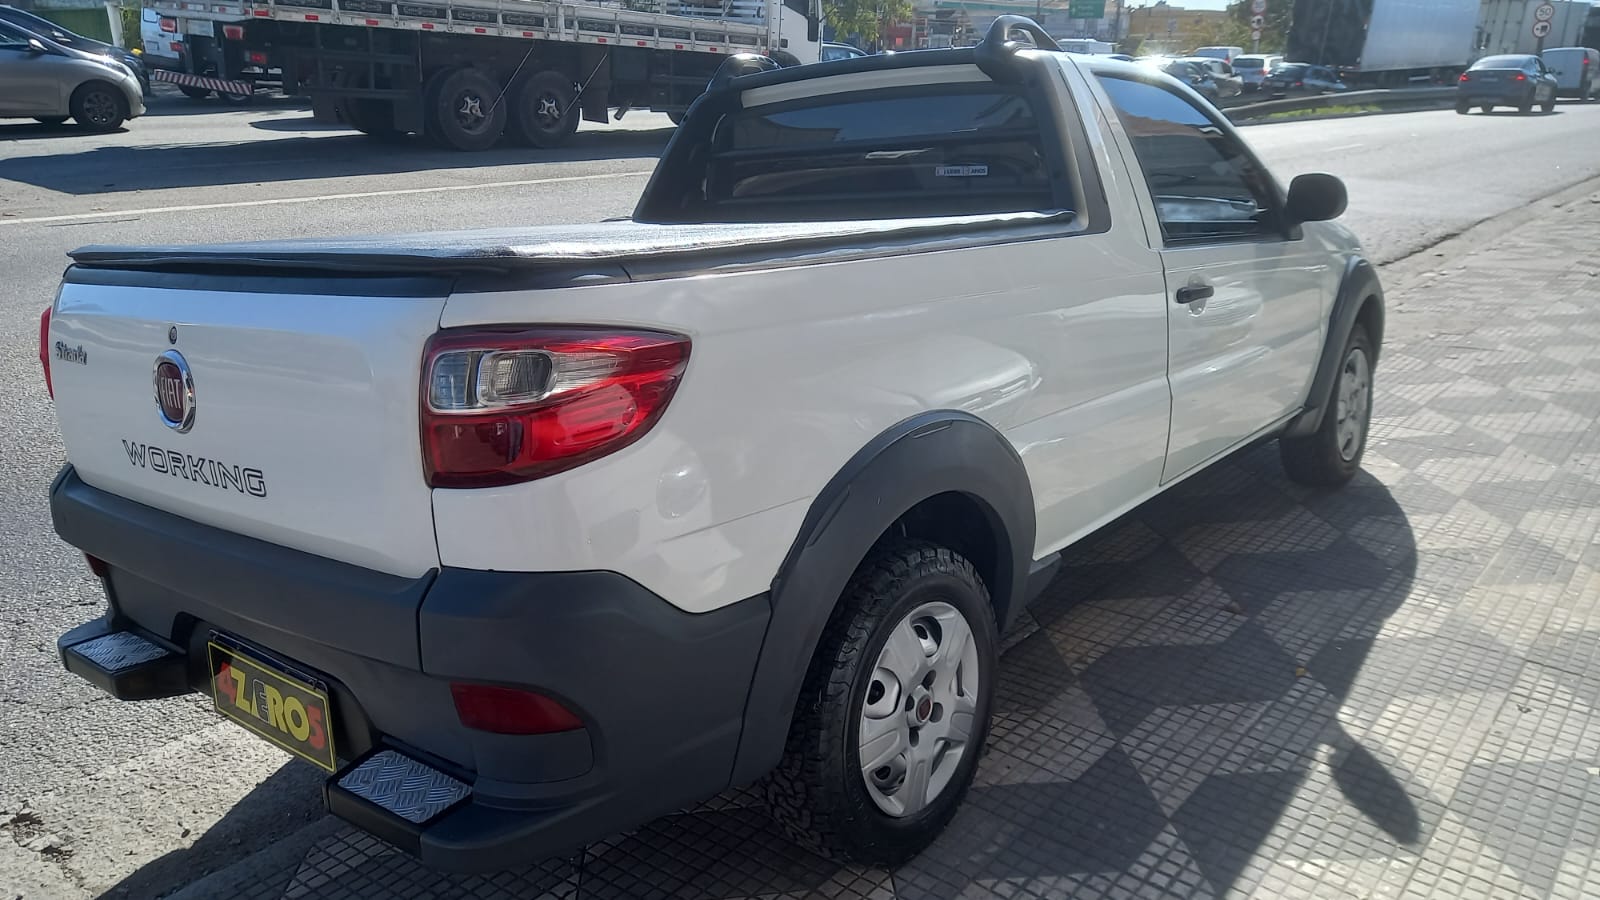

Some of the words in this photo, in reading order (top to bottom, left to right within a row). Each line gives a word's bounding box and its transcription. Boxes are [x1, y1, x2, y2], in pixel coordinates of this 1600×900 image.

[1538, 7, 1552, 17] 50
[159, 376, 182, 410] FIAT
[122, 439, 267, 498] WORKING
